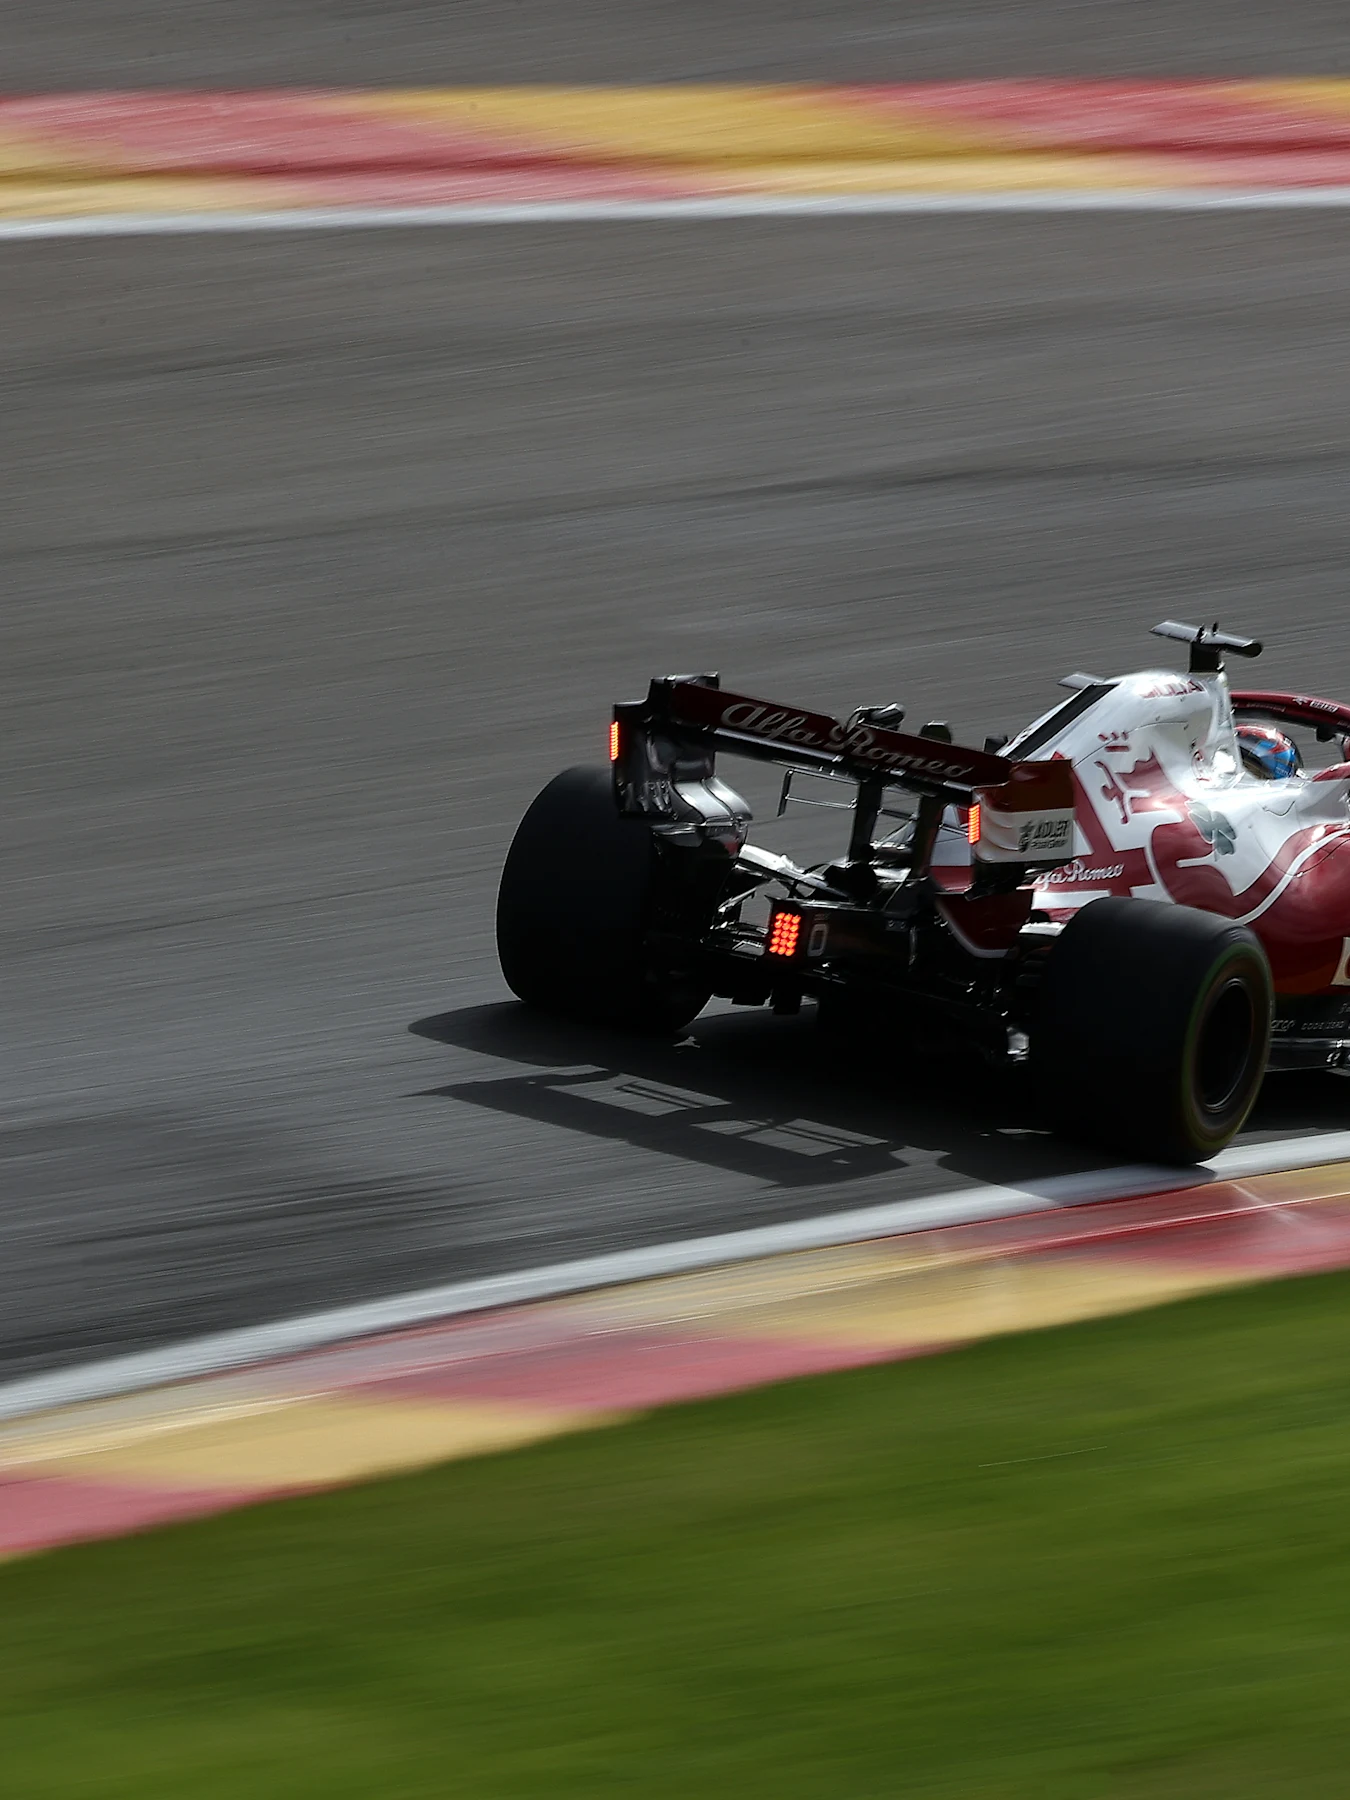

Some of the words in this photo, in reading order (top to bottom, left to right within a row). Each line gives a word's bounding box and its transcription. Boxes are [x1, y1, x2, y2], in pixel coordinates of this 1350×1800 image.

[720, 702, 824, 746] Alfa
[828, 723, 975, 778] Romeo
[1064, 859, 1125, 884] Romeo
